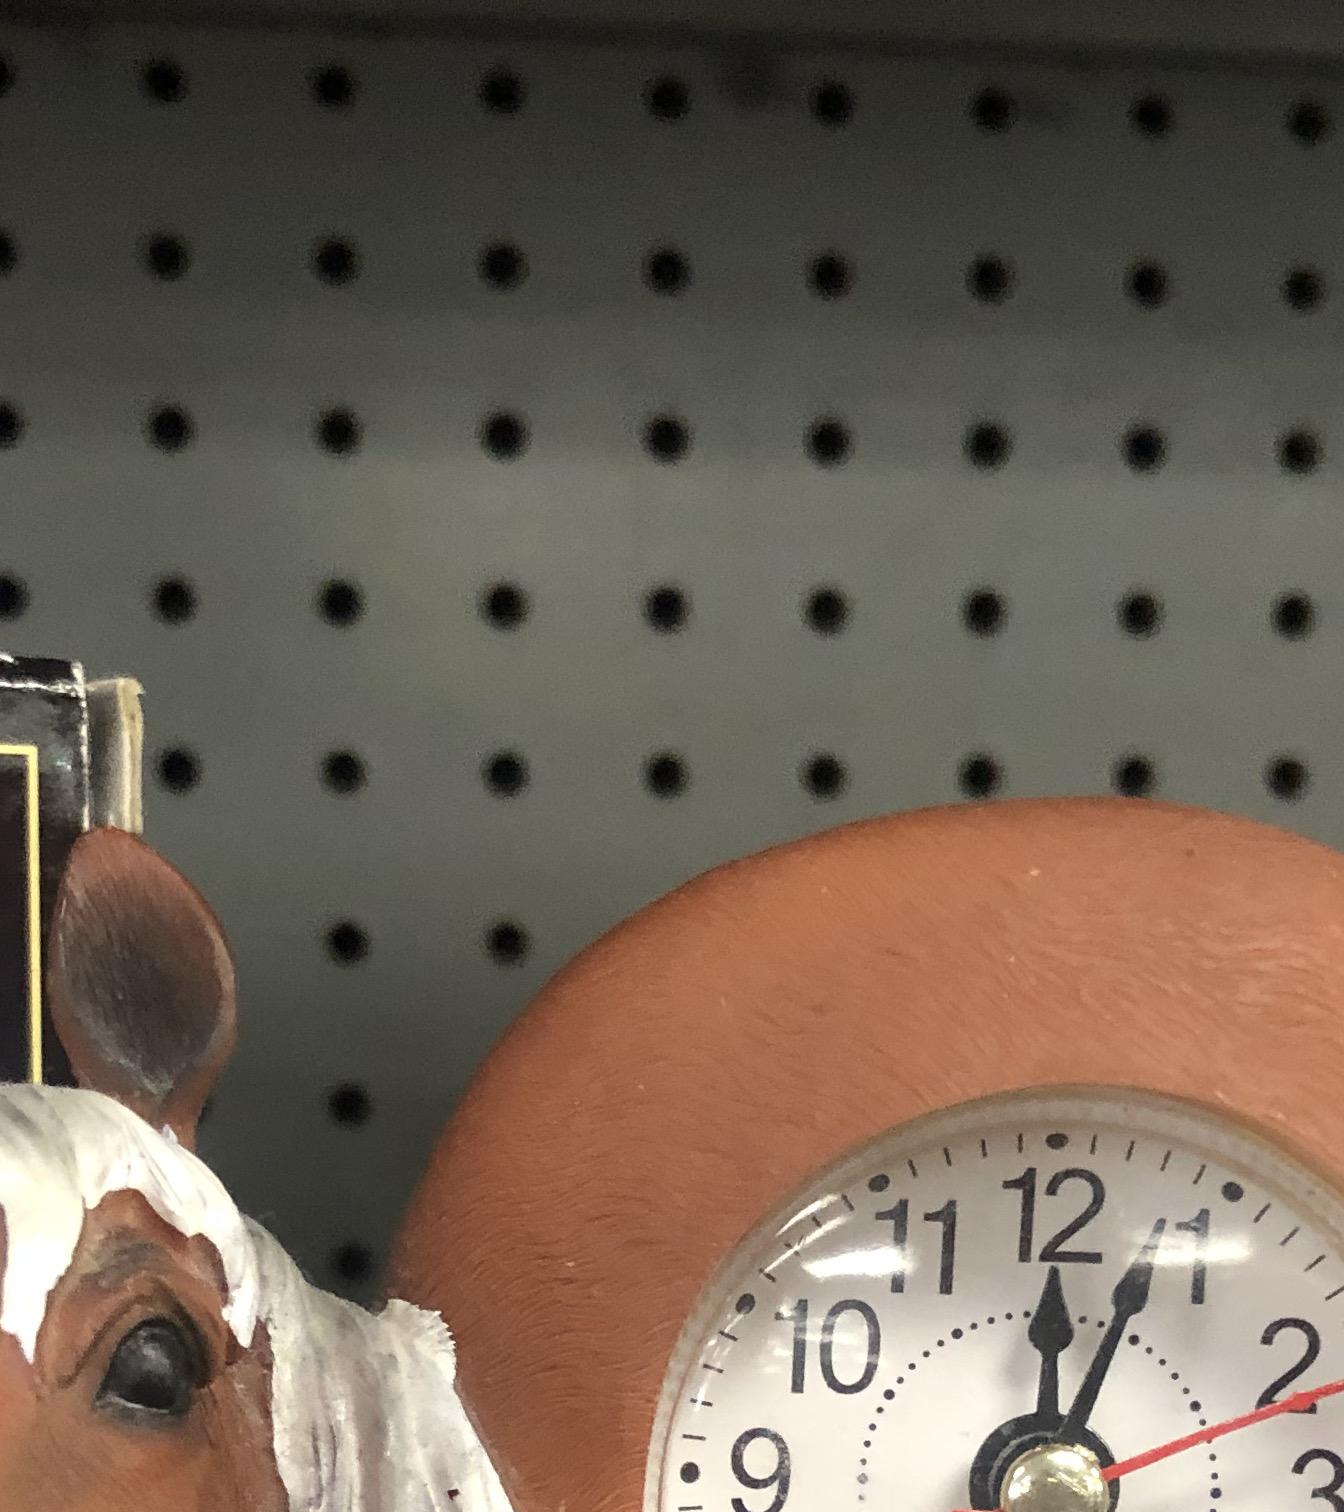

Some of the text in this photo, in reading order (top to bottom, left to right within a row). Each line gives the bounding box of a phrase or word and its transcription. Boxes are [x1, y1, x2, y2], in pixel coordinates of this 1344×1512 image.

[874, 1197, 959, 1296] 11
[1002, 1166, 1107, 1266] 12
[1175, 1207, 1212, 1306] 1
[774, 1298, 883, 1397] 10
[1255, 1317, 1323, 1415] 2
